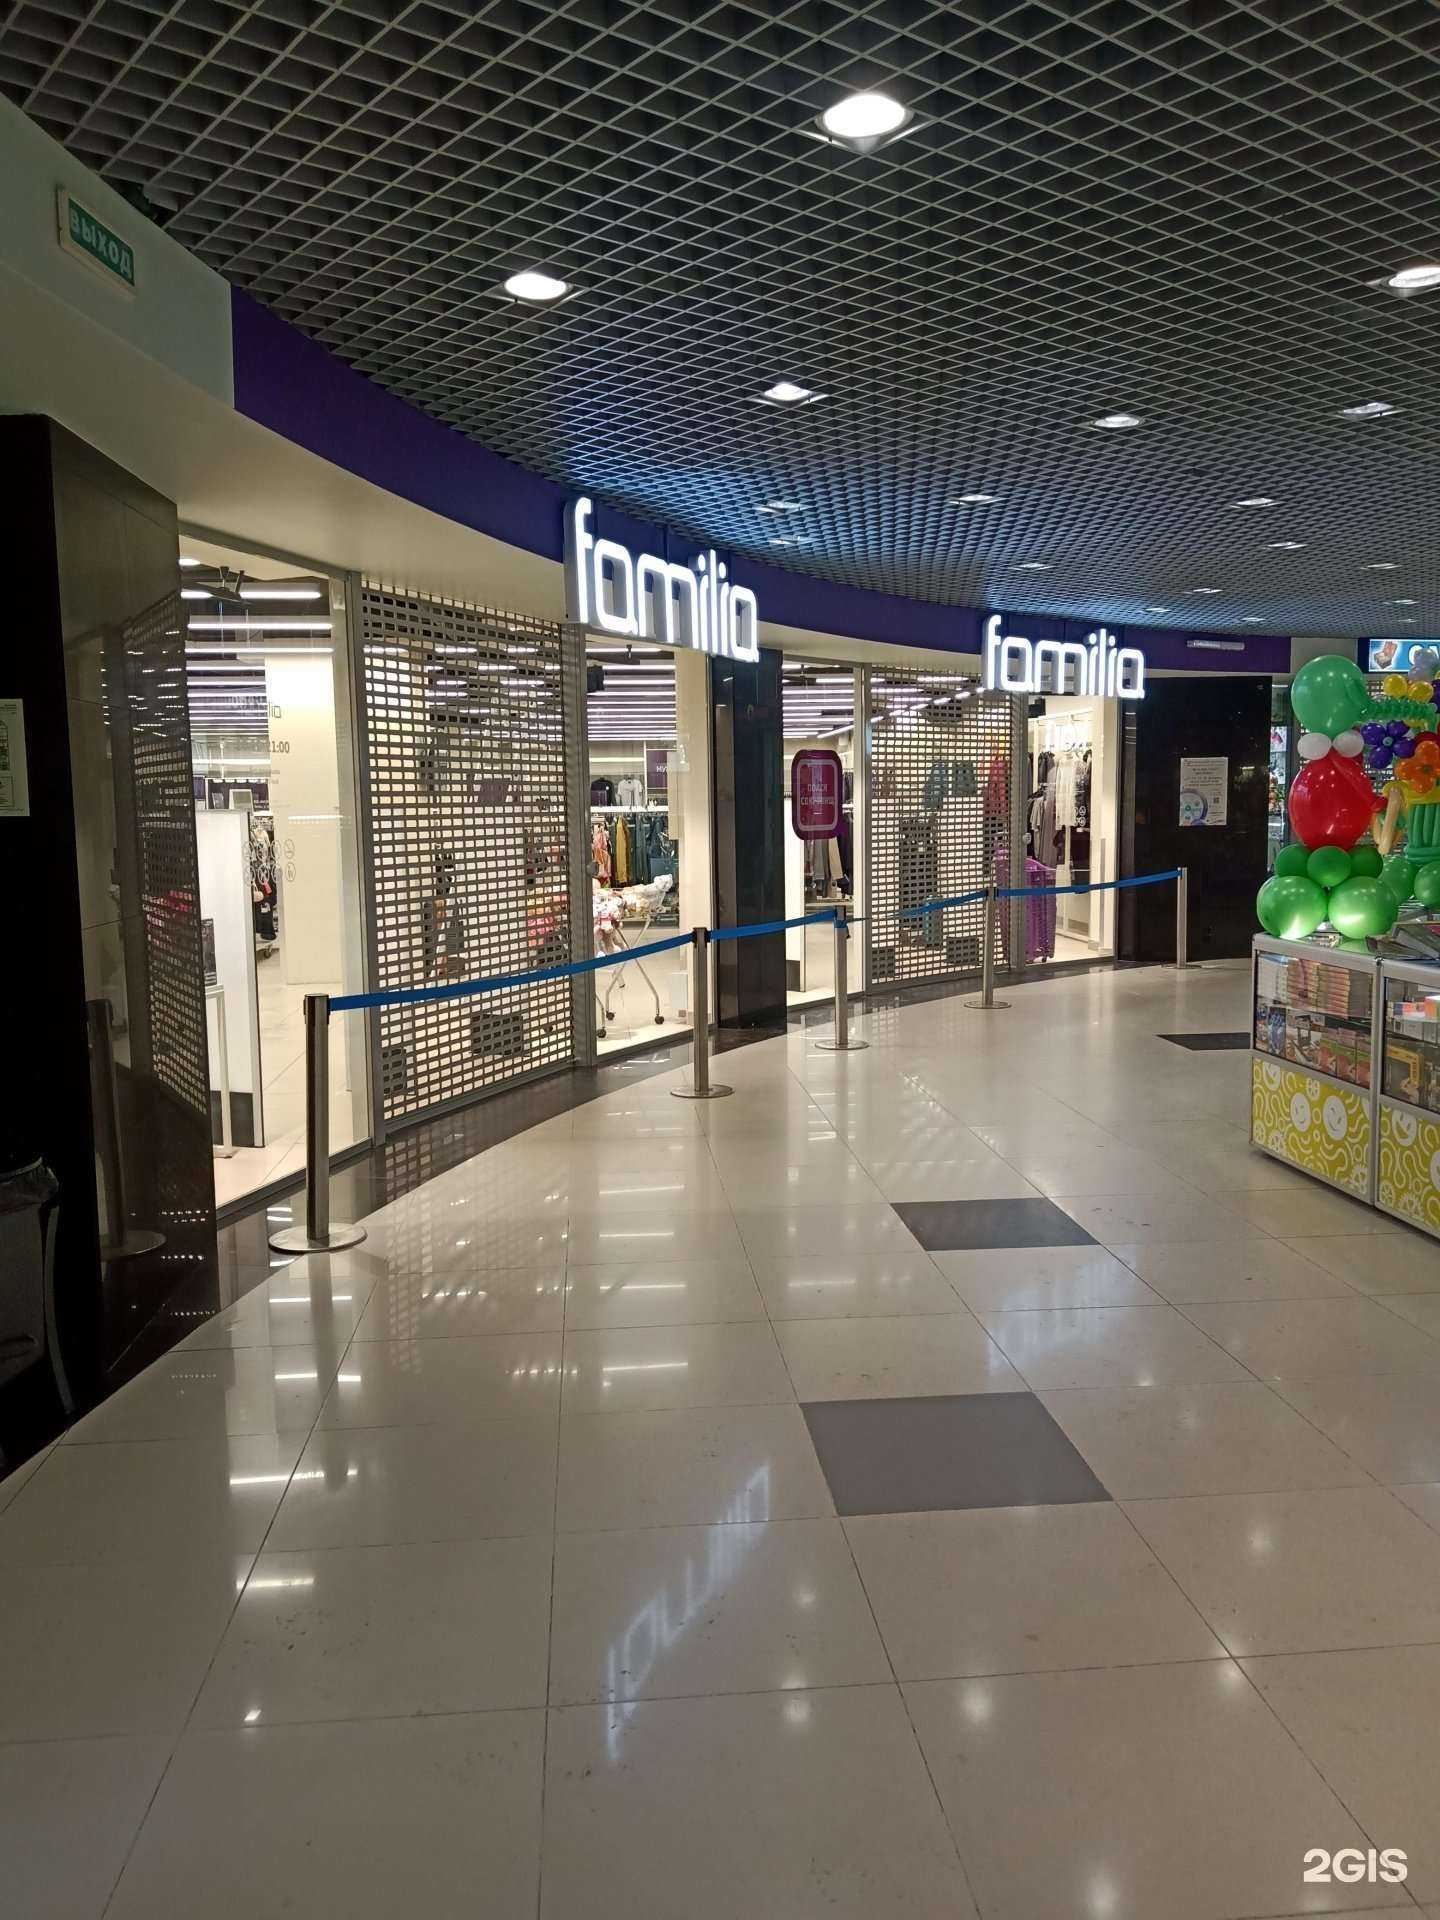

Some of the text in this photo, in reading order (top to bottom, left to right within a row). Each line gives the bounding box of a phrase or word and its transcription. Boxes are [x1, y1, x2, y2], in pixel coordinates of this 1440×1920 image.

[71, 208, 132, 280] ВЫХОД
[573, 496, 760, 663] familia
[986, 604, 1145, 699] familia
